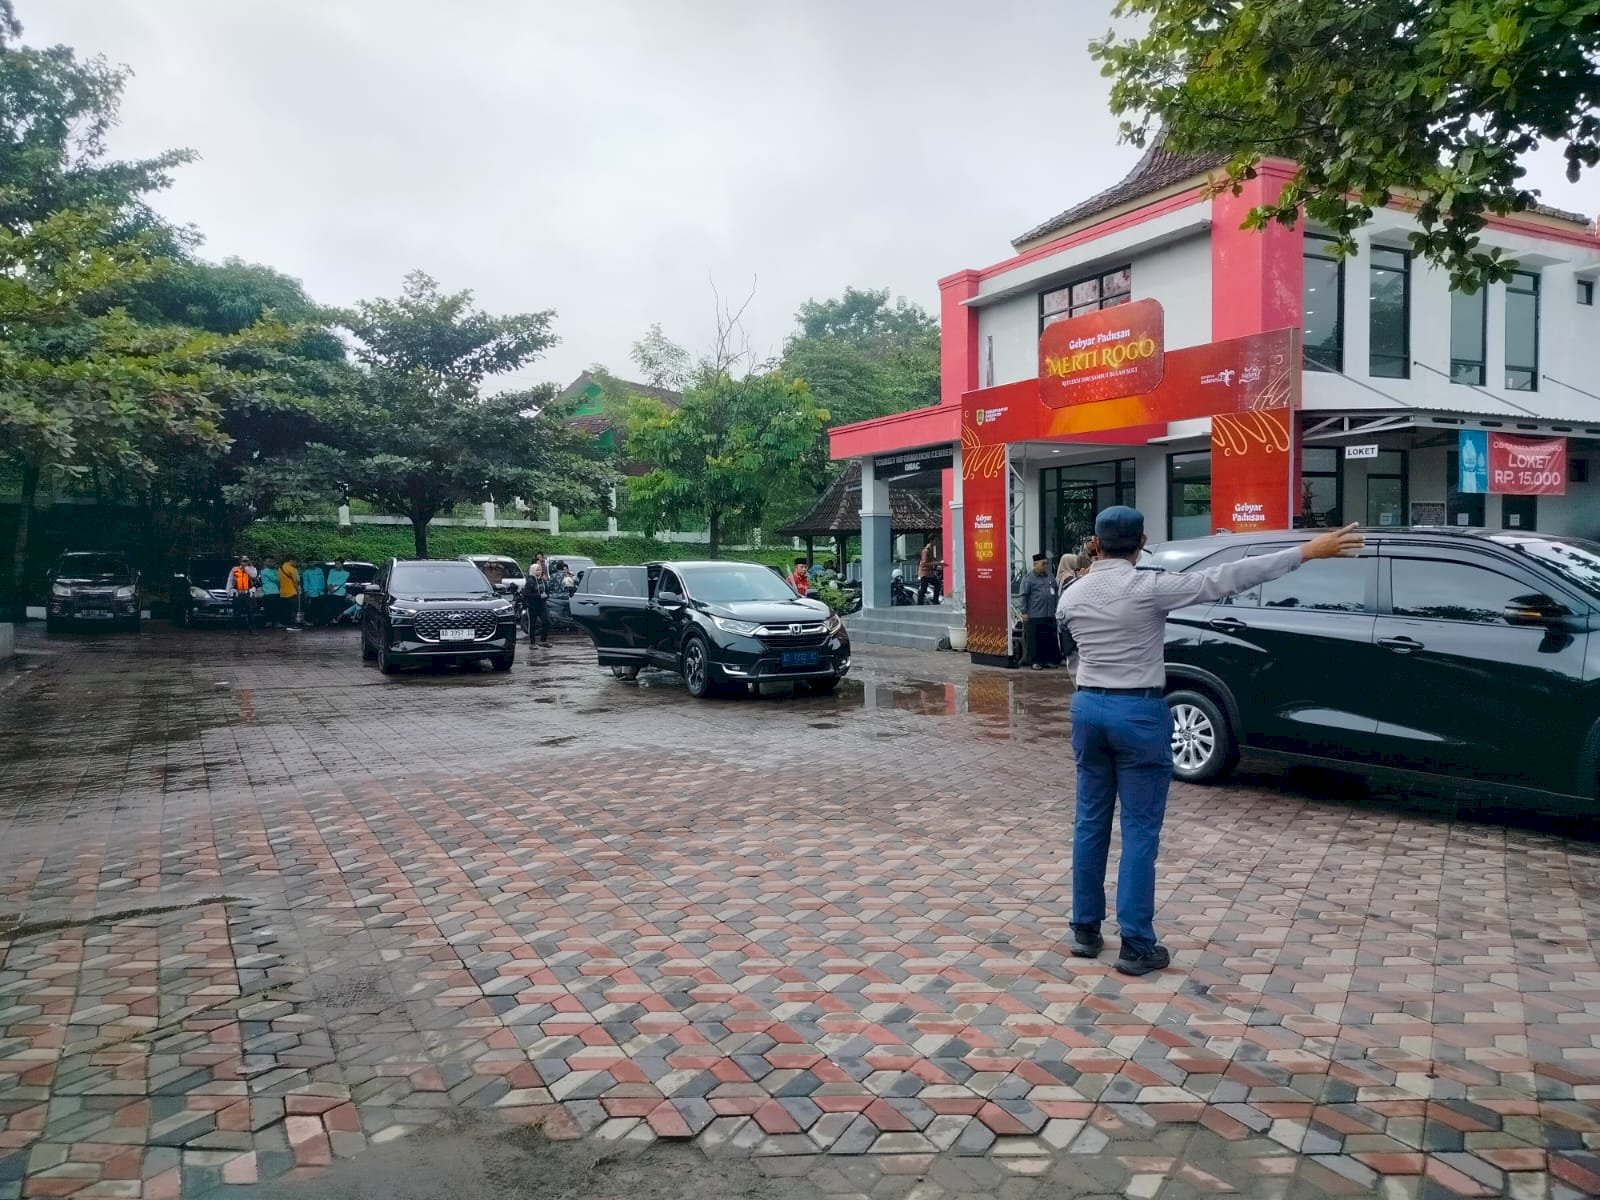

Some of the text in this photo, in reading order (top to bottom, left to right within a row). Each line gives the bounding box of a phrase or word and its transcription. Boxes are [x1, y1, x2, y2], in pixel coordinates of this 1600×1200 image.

[1069, 329, 1130, 350] Gebyar Padusan
[1045, 350, 1098, 378] MERTI
[1347, 447, 1375, 456] LOKET
[1508, 454, 1551, 469] LOKET
[1495, 470, 1561, 486] RP. 15.000
[1234, 502, 1263, 514] Gebyar
[1232, 512, 1265, 522] Padusan
